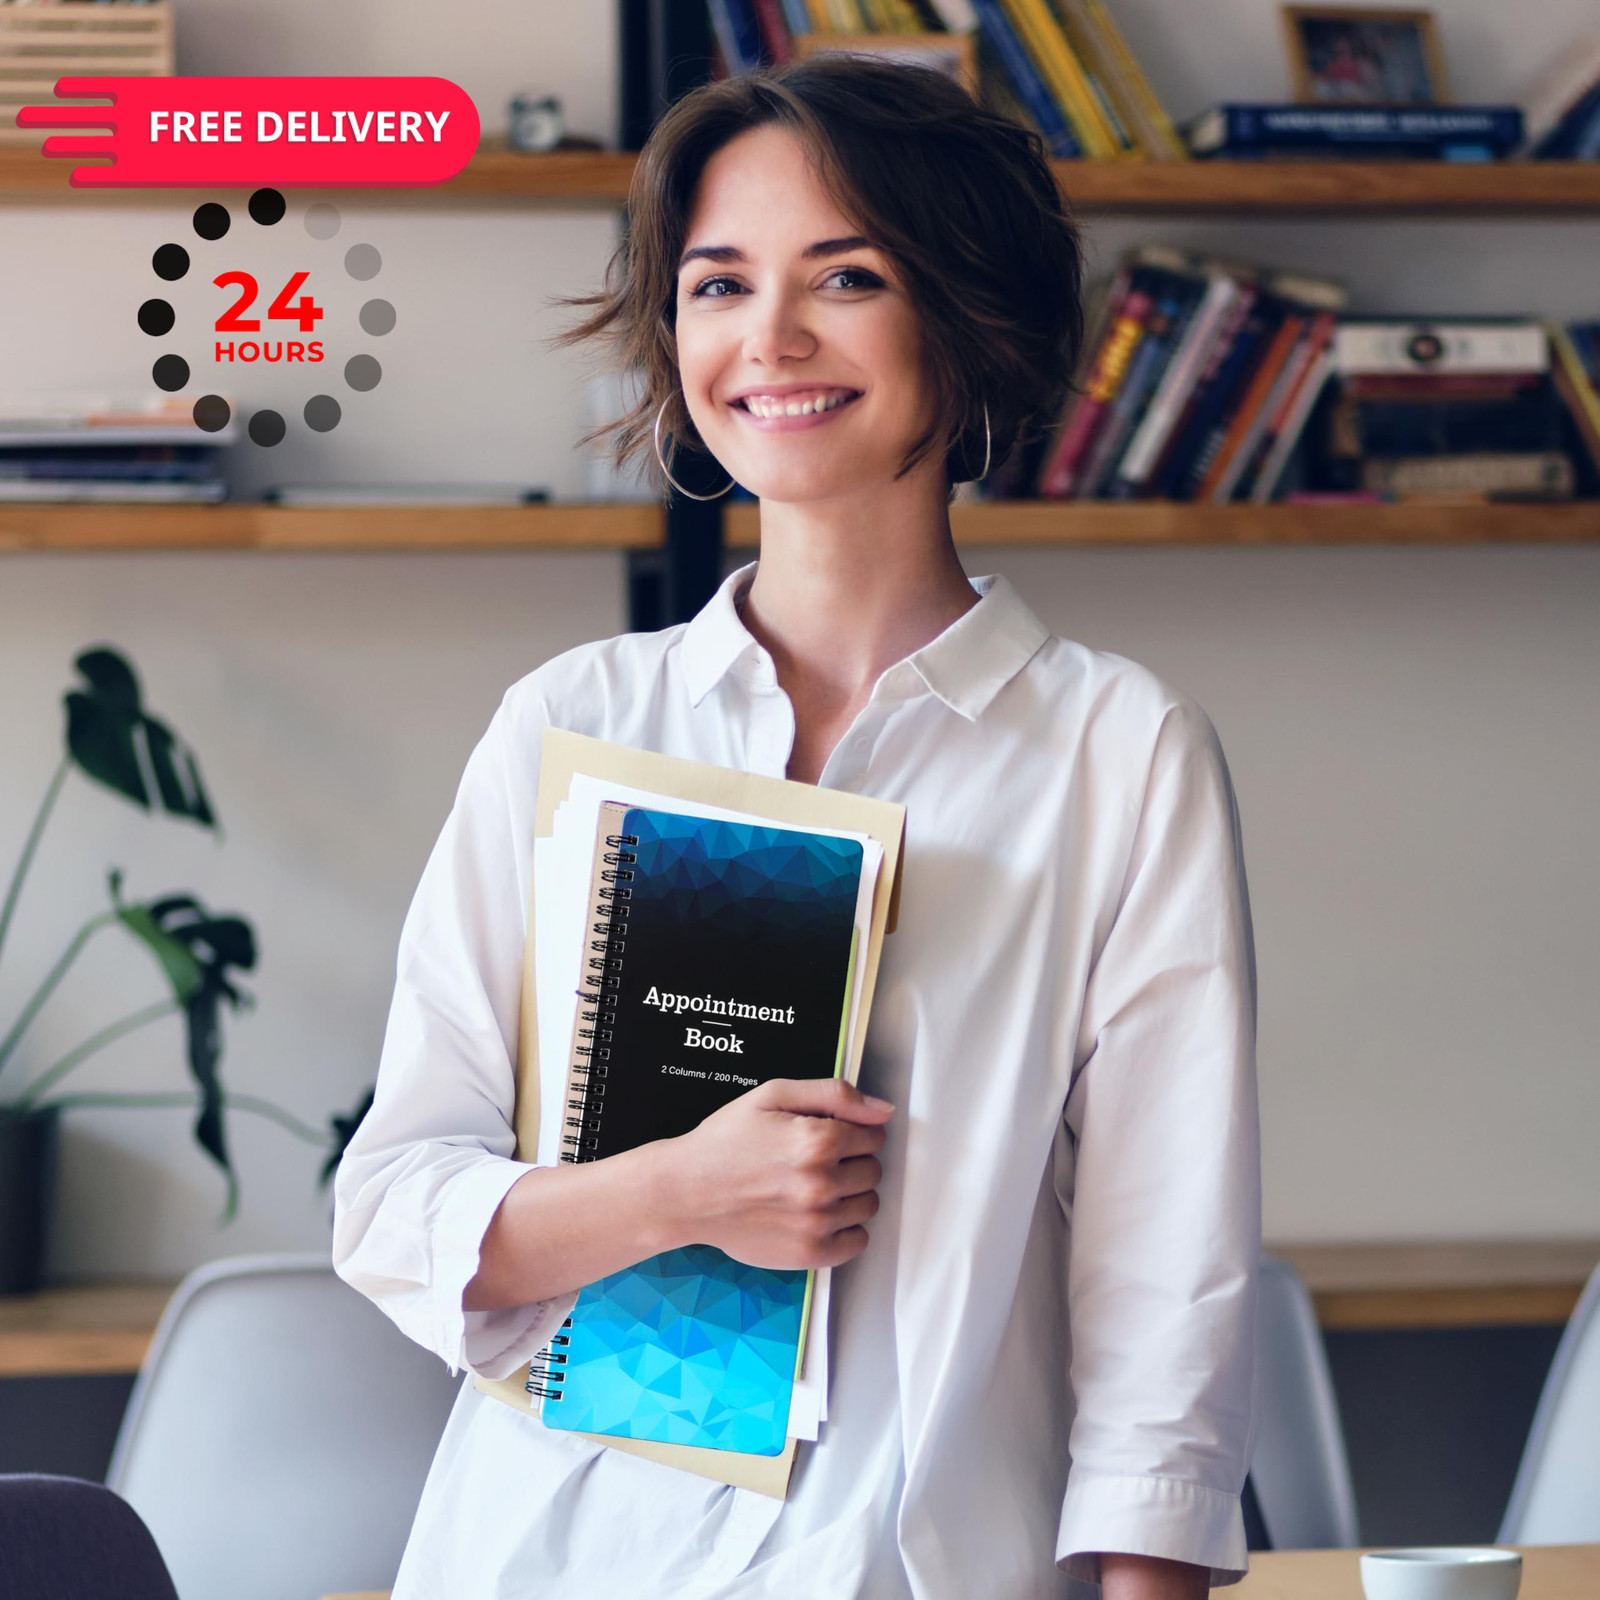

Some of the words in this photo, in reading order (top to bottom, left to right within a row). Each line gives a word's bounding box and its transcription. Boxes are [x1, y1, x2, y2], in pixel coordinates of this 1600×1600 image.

[642, 986, 795, 1024] Appointment
[683, 1027, 745, 1054] Book
[660, 1064, 668, 1074] 2
[668, 1065, 707, 1079] Columns
[707, 1071, 713, 1080] /
[714, 1072, 731, 1082] 200
[732, 1074, 758, 1086] Pages
